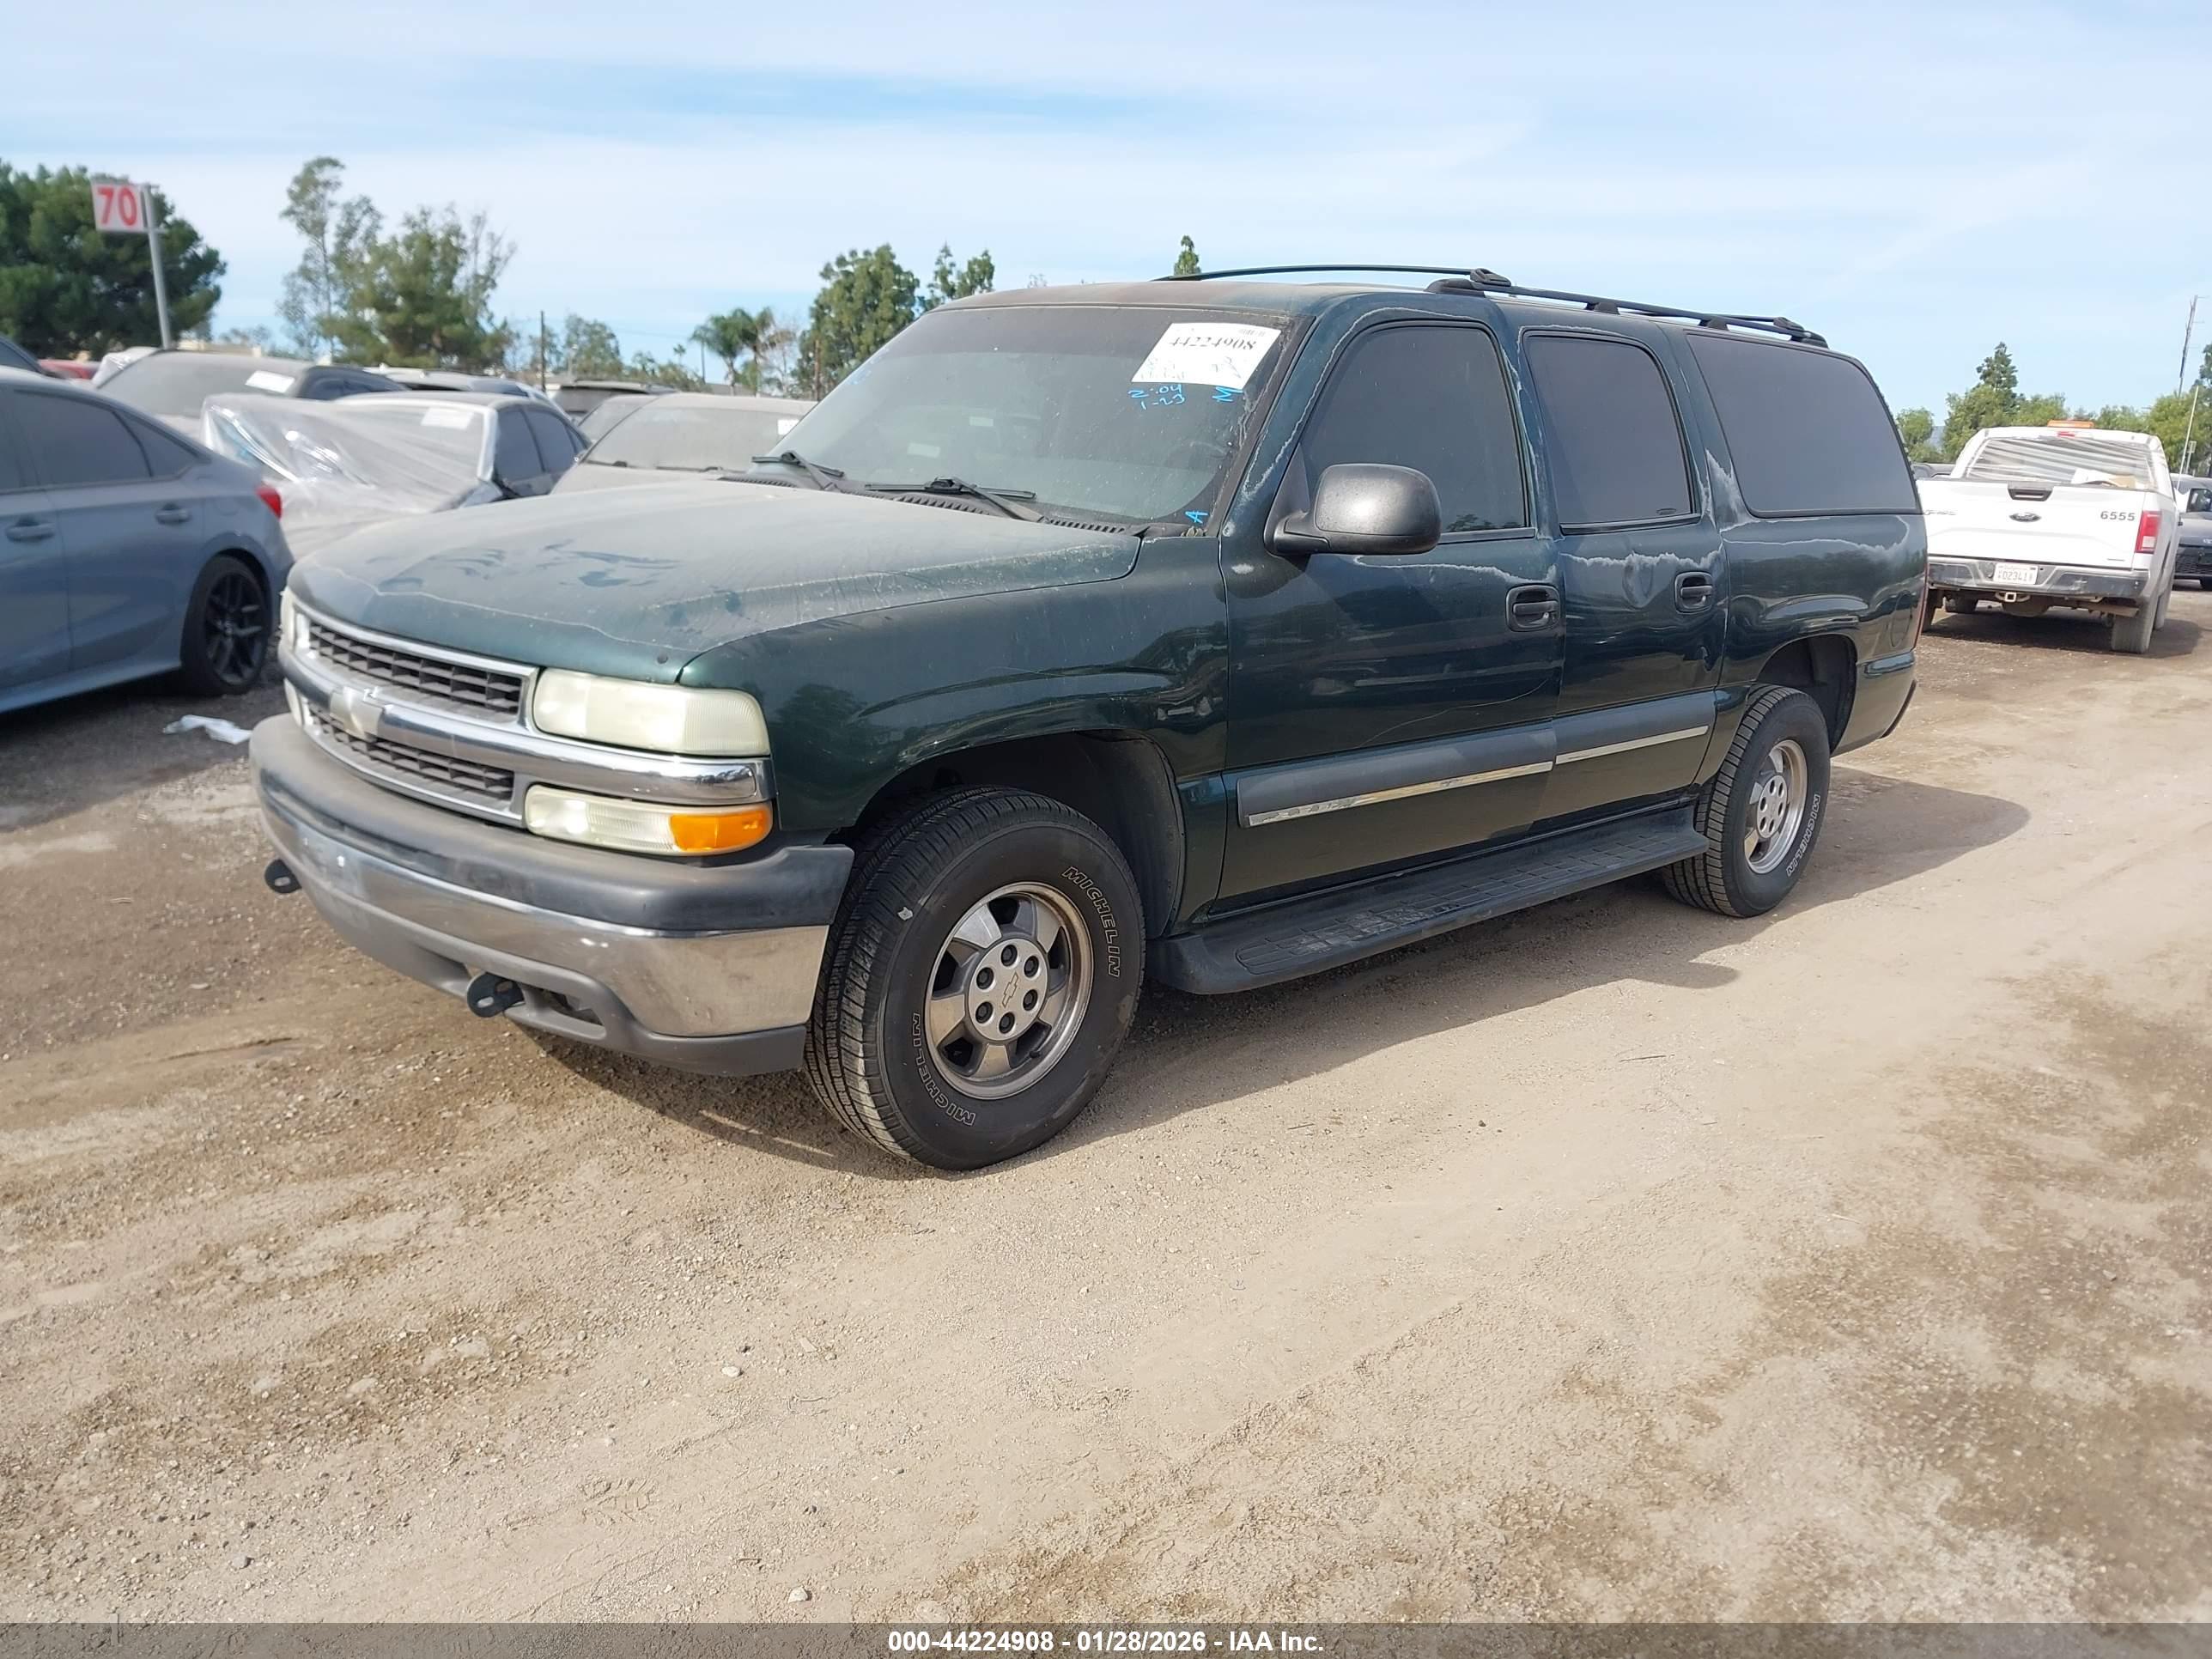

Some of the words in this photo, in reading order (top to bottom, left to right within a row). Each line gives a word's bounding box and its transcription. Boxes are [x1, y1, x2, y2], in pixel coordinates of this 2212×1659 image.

[96, 186, 137, 227] 70
[1170, 337, 1257, 350] 44224908
[2100, 510, 2136, 522] 6555
[1786, 793, 1820, 877] MICHELIN
[1061, 866, 1121, 978] MICHELIN
[913, 1012, 976, 1126] MICHELIN
